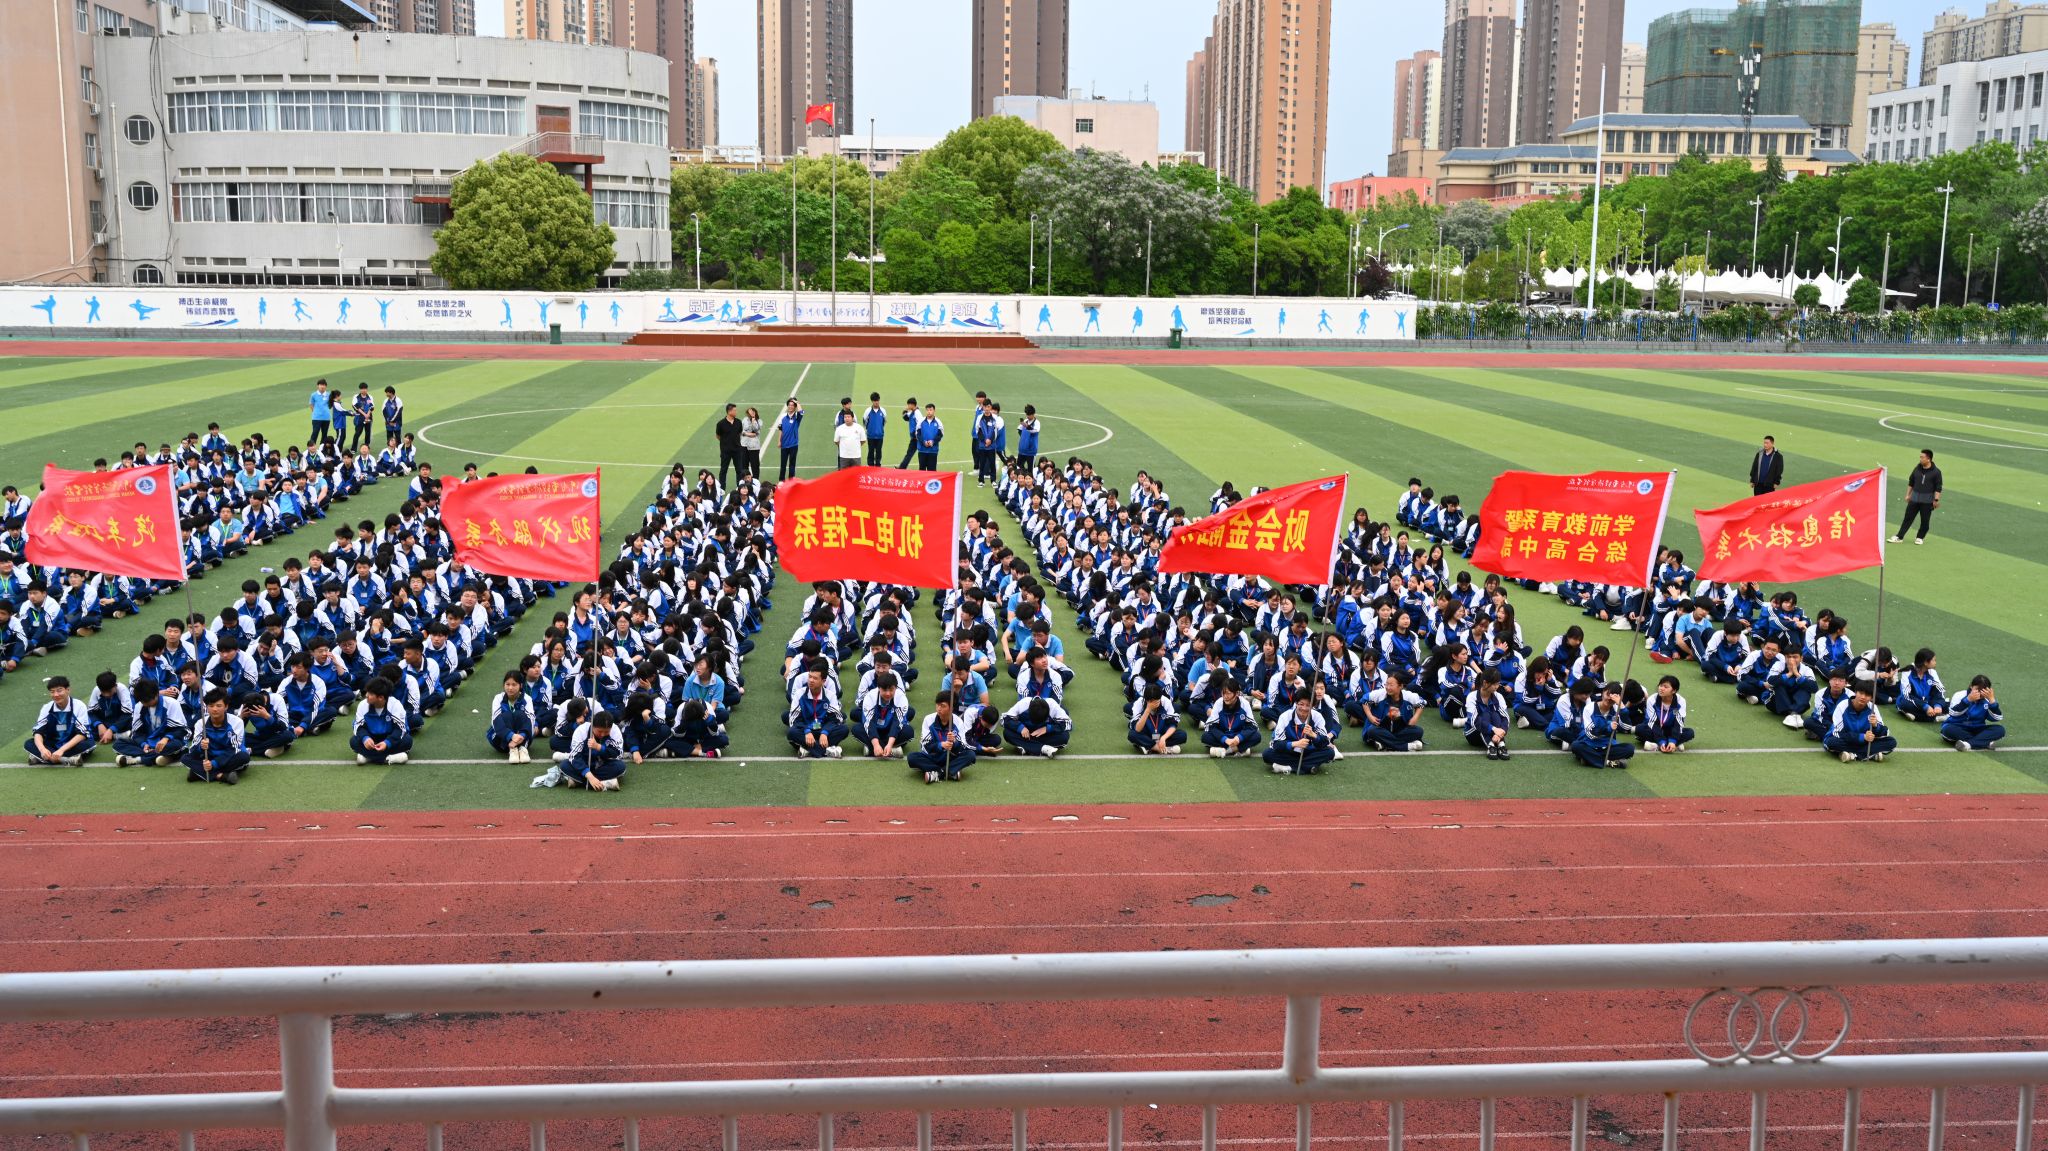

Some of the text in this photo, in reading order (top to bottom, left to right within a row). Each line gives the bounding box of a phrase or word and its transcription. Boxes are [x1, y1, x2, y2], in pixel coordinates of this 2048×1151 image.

[417, 299, 466, 308] 扬起梦想之帆
[688, 299, 716, 313] 品正
[424, 309, 472, 318] 点燃体育之火
